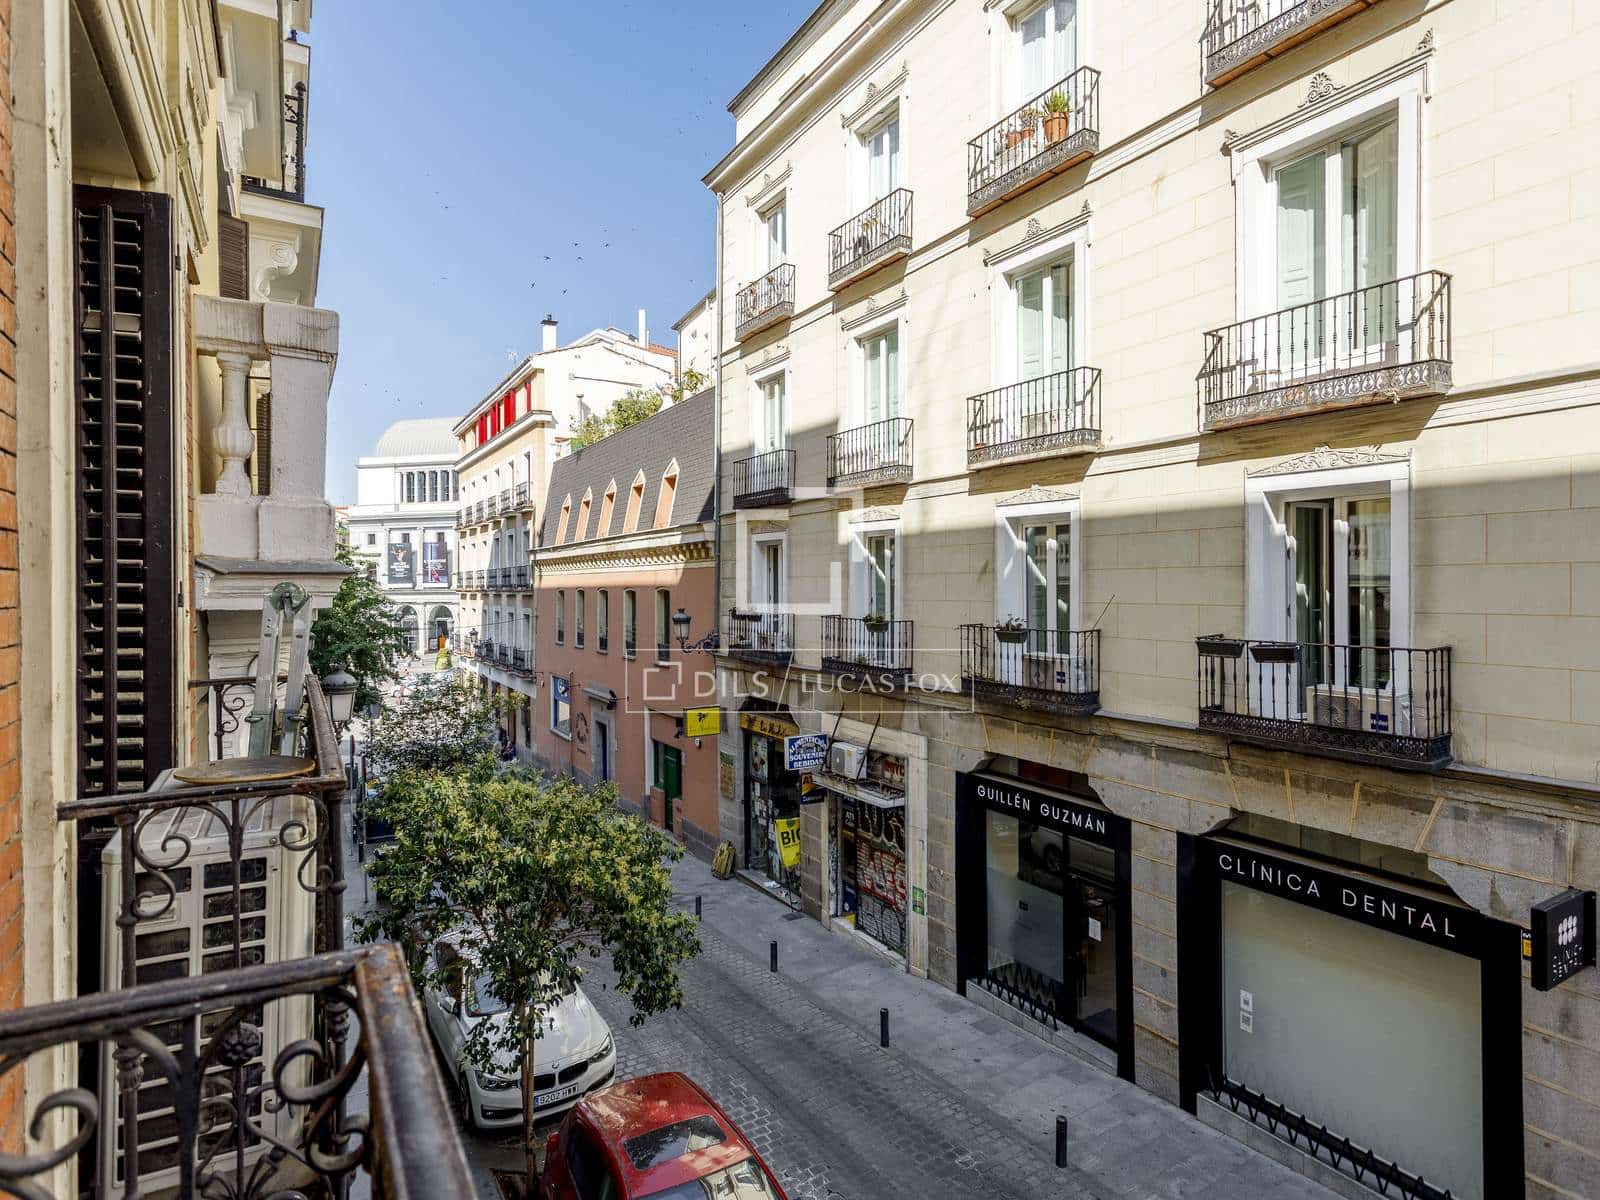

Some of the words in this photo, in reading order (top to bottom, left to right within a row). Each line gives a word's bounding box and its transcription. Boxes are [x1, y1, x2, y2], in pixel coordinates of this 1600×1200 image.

[793, 758, 825, 769] BEBIDAS
[977, 785, 1030, 812] GUILLÉN
[1040, 803, 1105, 834] GUZMÁN
[1219, 854, 1320, 898] CLÍNICA
[1342, 888, 1456, 938] DENTAL
